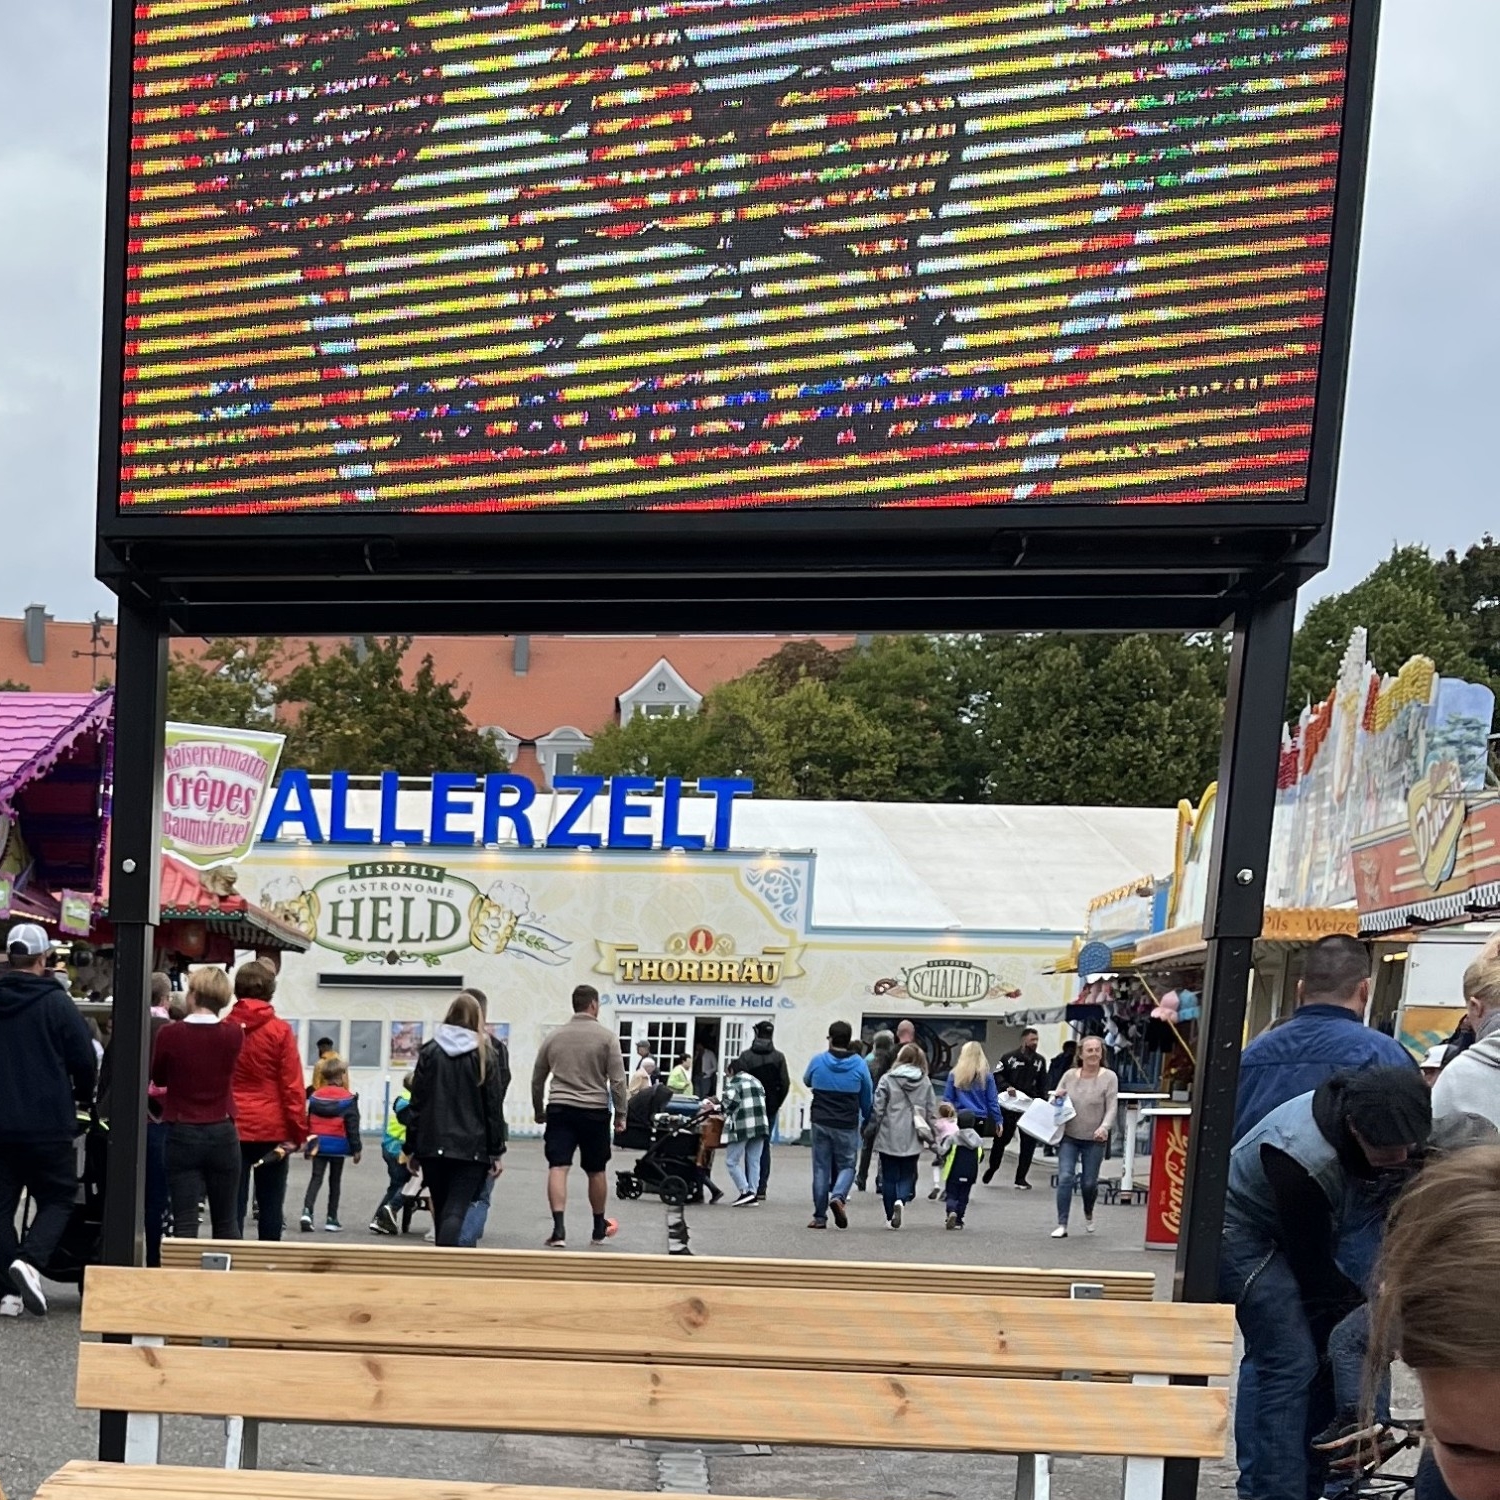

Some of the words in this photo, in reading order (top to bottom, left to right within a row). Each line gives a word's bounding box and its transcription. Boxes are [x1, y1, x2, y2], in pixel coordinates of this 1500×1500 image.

[167, 770, 258, 819] Crêpes
[260, 768, 755, 850] ALLERZELT
[354, 864, 441, 879] FESTZELT
[337, 881, 455, 899] GASTRONOMIE
[327, 896, 462, 944] HELD
[1306, 916, 1359, 933] Weize
[619, 957, 782, 986] THORBRÄU
[912, 969, 983, 999] SCHALLER
[616, 993, 686, 1007] Wirtsleute
[689, 994, 737, 1008] Familie
[740, 995, 774, 1009] Held
